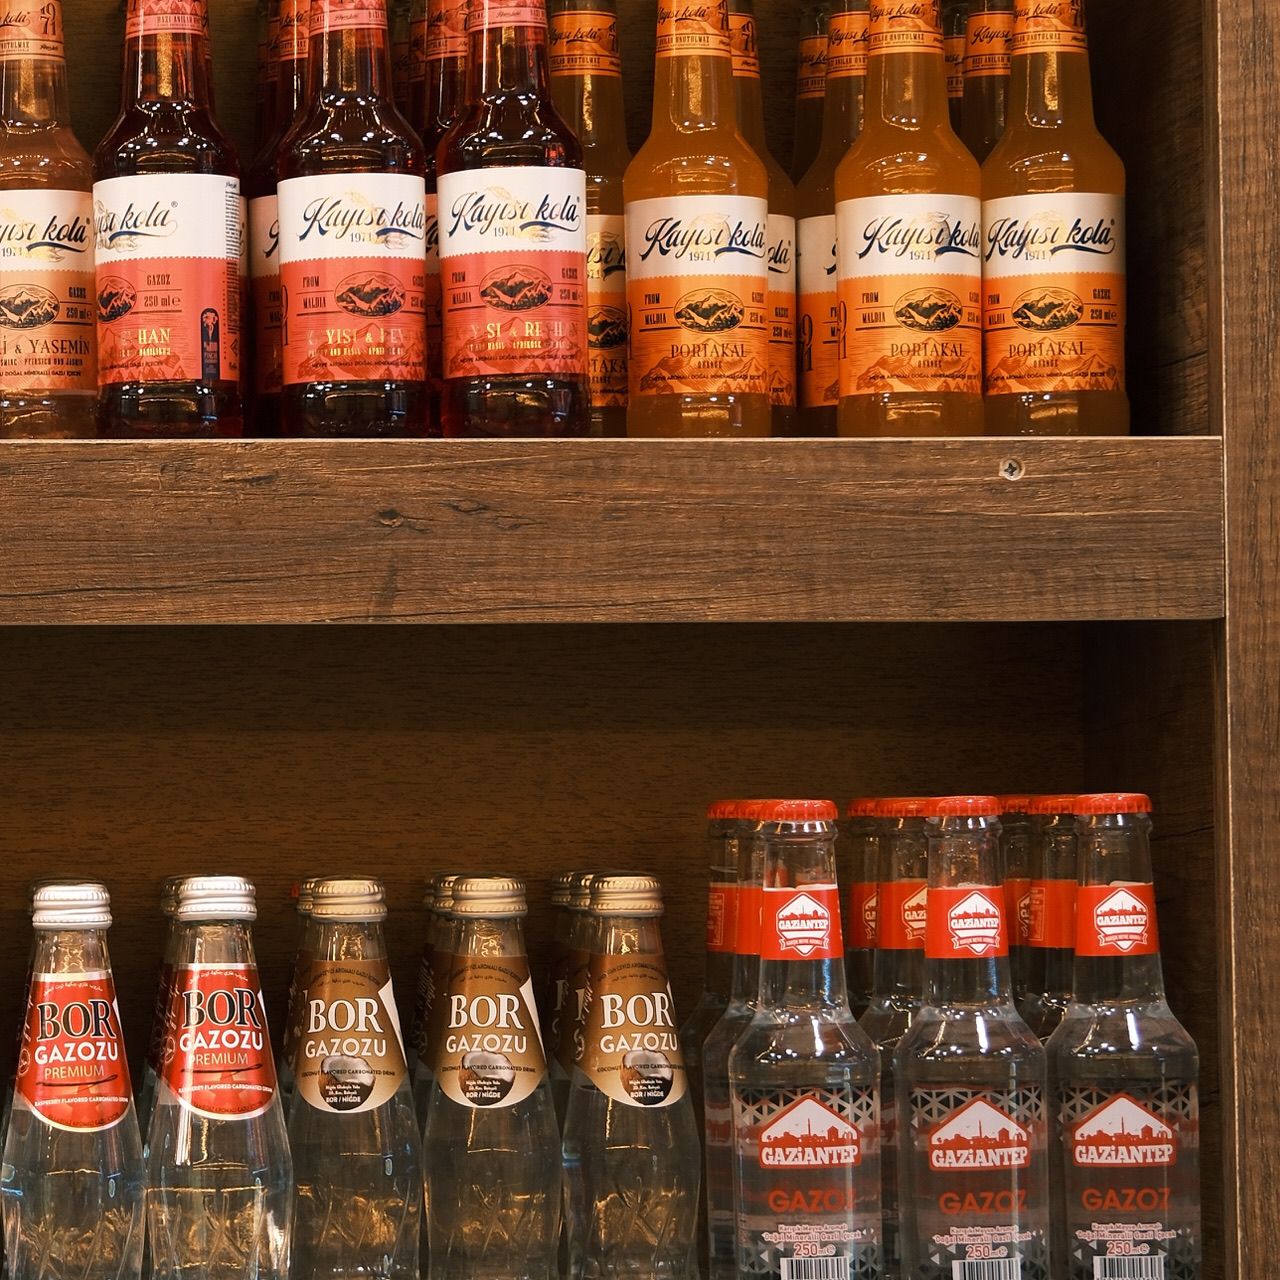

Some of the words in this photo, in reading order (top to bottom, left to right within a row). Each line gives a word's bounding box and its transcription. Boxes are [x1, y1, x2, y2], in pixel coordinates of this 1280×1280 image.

[535, 194, 580, 230] kola
[729, 221, 766, 256] kola
[949, 220, 980, 256] kola
[689, 251, 710, 262] 1971
[147, 275, 170, 285] GAZOZ
[144, 295, 159, 307] 250
[671, 343, 747, 359] PORTAKAL
[891, 342, 965, 357] PORTAKAL
[37, 999, 117, 1041] BOR
[182, 988, 261, 1029] BOR
[307, 998, 384, 1033] BOR
[448, 994, 524, 1029] BOR
[180, 1029, 263, 1052] GAZOZU
[305, 1038, 386, 1058] GAZOZU
[446, 1034, 526, 1053] GAZOZU
[35, 1042, 118, 1065] GAZOZU
[190, 1052, 248, 1065] PREMIUM
[45, 1066, 104, 1080] PREMIUM
[768, 1188, 856, 1212] GAZOZ
[939, 1189, 1028, 1214] GAZOZ
[1081, 1188, 1170, 1211] GAZOZ
